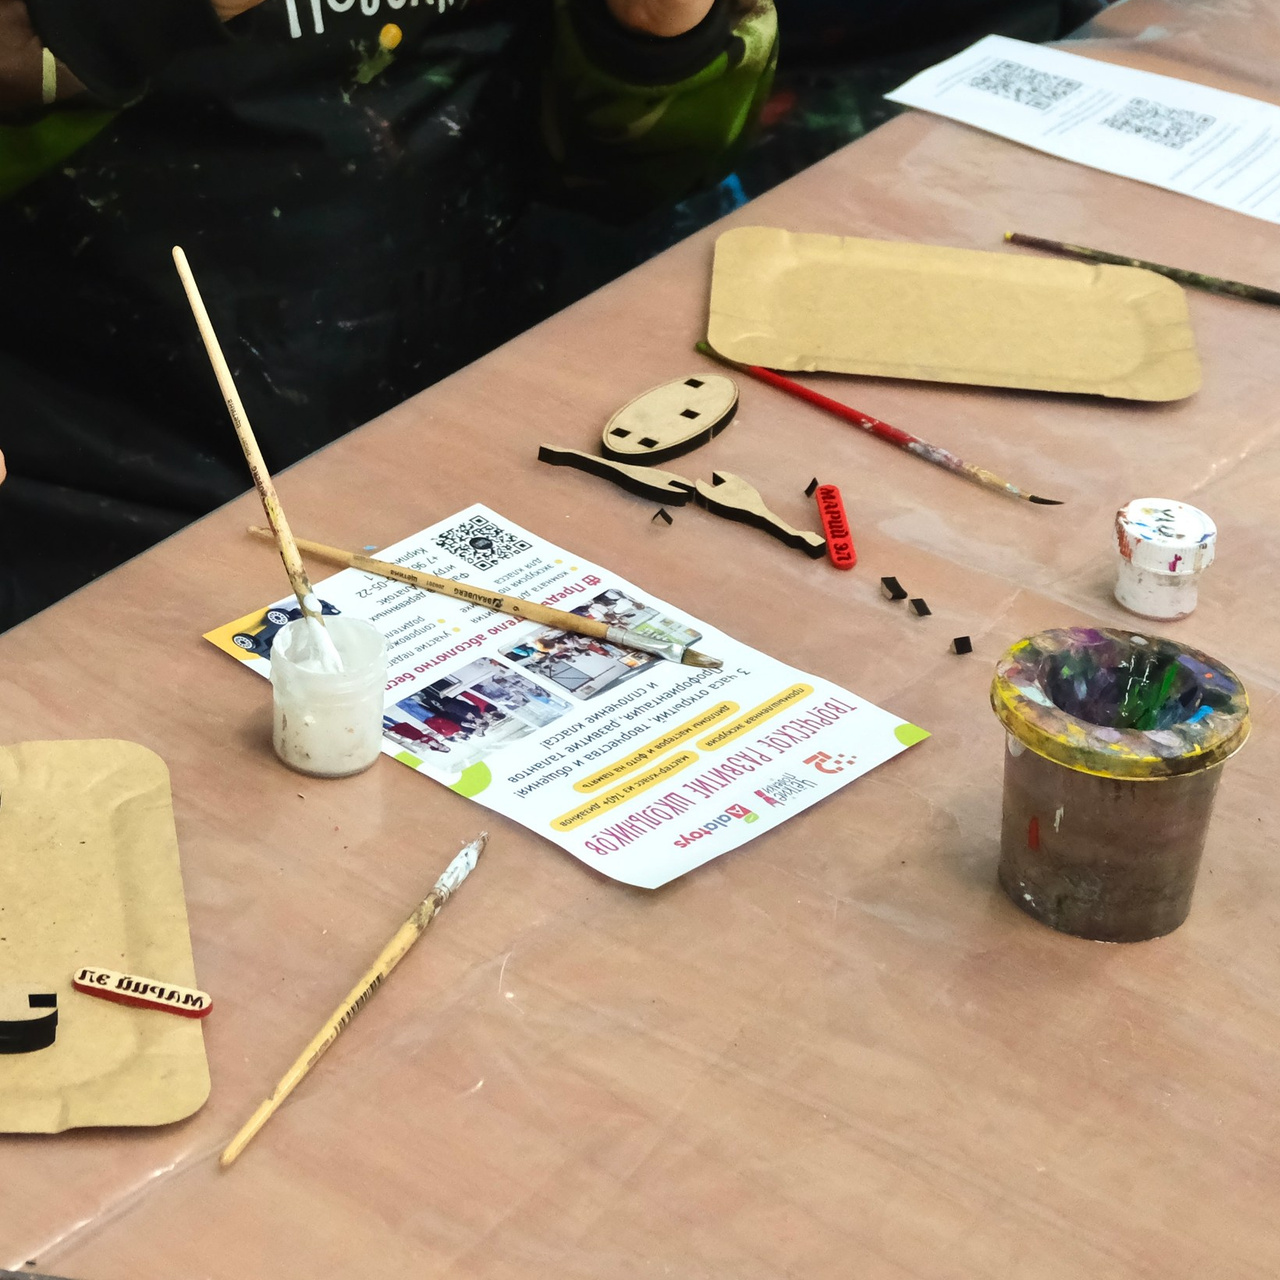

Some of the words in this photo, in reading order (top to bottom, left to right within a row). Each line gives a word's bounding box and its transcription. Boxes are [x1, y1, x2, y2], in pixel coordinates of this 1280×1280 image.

[820, 487, 849, 539] МАРИЙ
[426, 555, 438, 564] +7
[524, 557, 542, 569] для
[493, 567, 524, 584] класса
[510, 564, 554, 587] экскурсия
[530, 571, 568, 592] комната
[369, 591, 426, 621] деревянных
[453, 587, 492, 604] BRAUBERG
[413, 633, 486, 672] абсолютно
[414, 630, 451, 652] участие
[707, 674, 737, 689] часа
[736, 667, 750, 675] 3
[646, 681, 658, 689] и
[584, 687, 646, 723] сплочение
[648, 689, 709, 723] открытий,
[692, 704, 729, 728] дипломы
[744, 687, 804, 724] промышленная
[539, 722, 585, 749] класса!
[564, 719, 620, 752] развитие
[705, 723, 745, 746] экскурсия
[757, 697, 856, 753] ТВОРЧЕСКОЕ
[583, 723, 650, 760] творчества
[654, 727, 692, 749] мастеров
[507, 752, 565, 782] талантов
[612, 764, 626, 772] на
[625, 753, 648, 766] фото
[633, 755, 689, 786] мастер-класс
[513, 765, 572, 798] общения!
[581, 771, 614, 787] память
[683, 747, 771, 798] РАЗВИТИЕ
[602, 792, 624, 804] 140+
[622, 785, 635, 793] из
[559, 802, 600, 826] дизайнов
[585, 792, 694, 855] ШКОЛЬНИКОВ
[673, 814, 731, 848] alatoys
